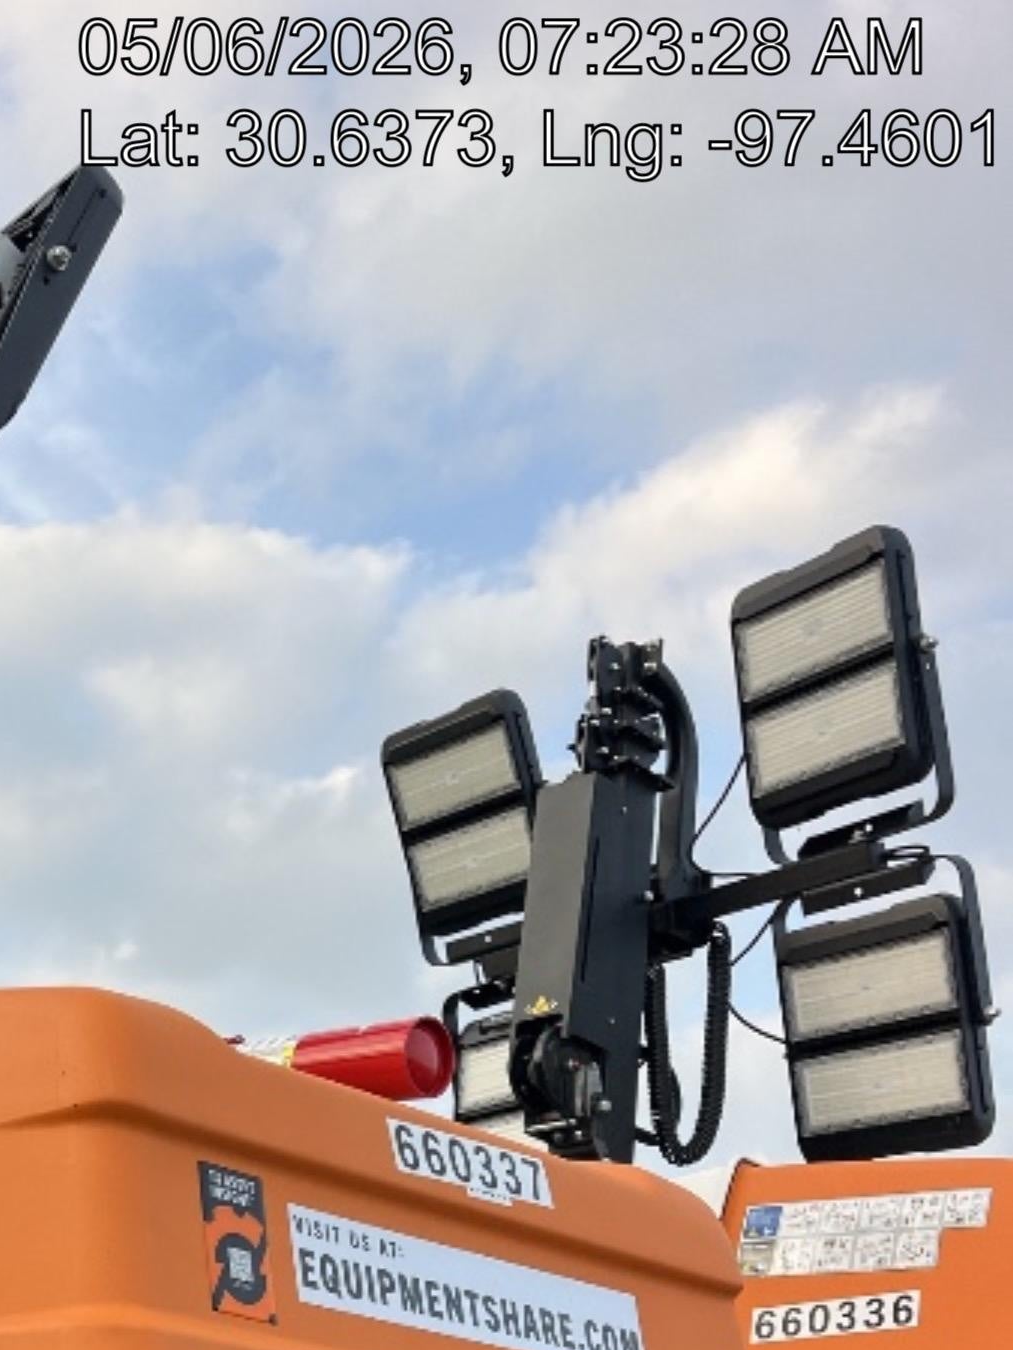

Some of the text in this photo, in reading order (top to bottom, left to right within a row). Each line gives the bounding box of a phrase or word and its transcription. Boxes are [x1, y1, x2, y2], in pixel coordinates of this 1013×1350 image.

[395, 1123, 542, 1200] 660337
[292, 1214, 340, 1244] VISIT
[349, 1229, 371, 1252] US
[755, 1294, 916, 1340] 660336
